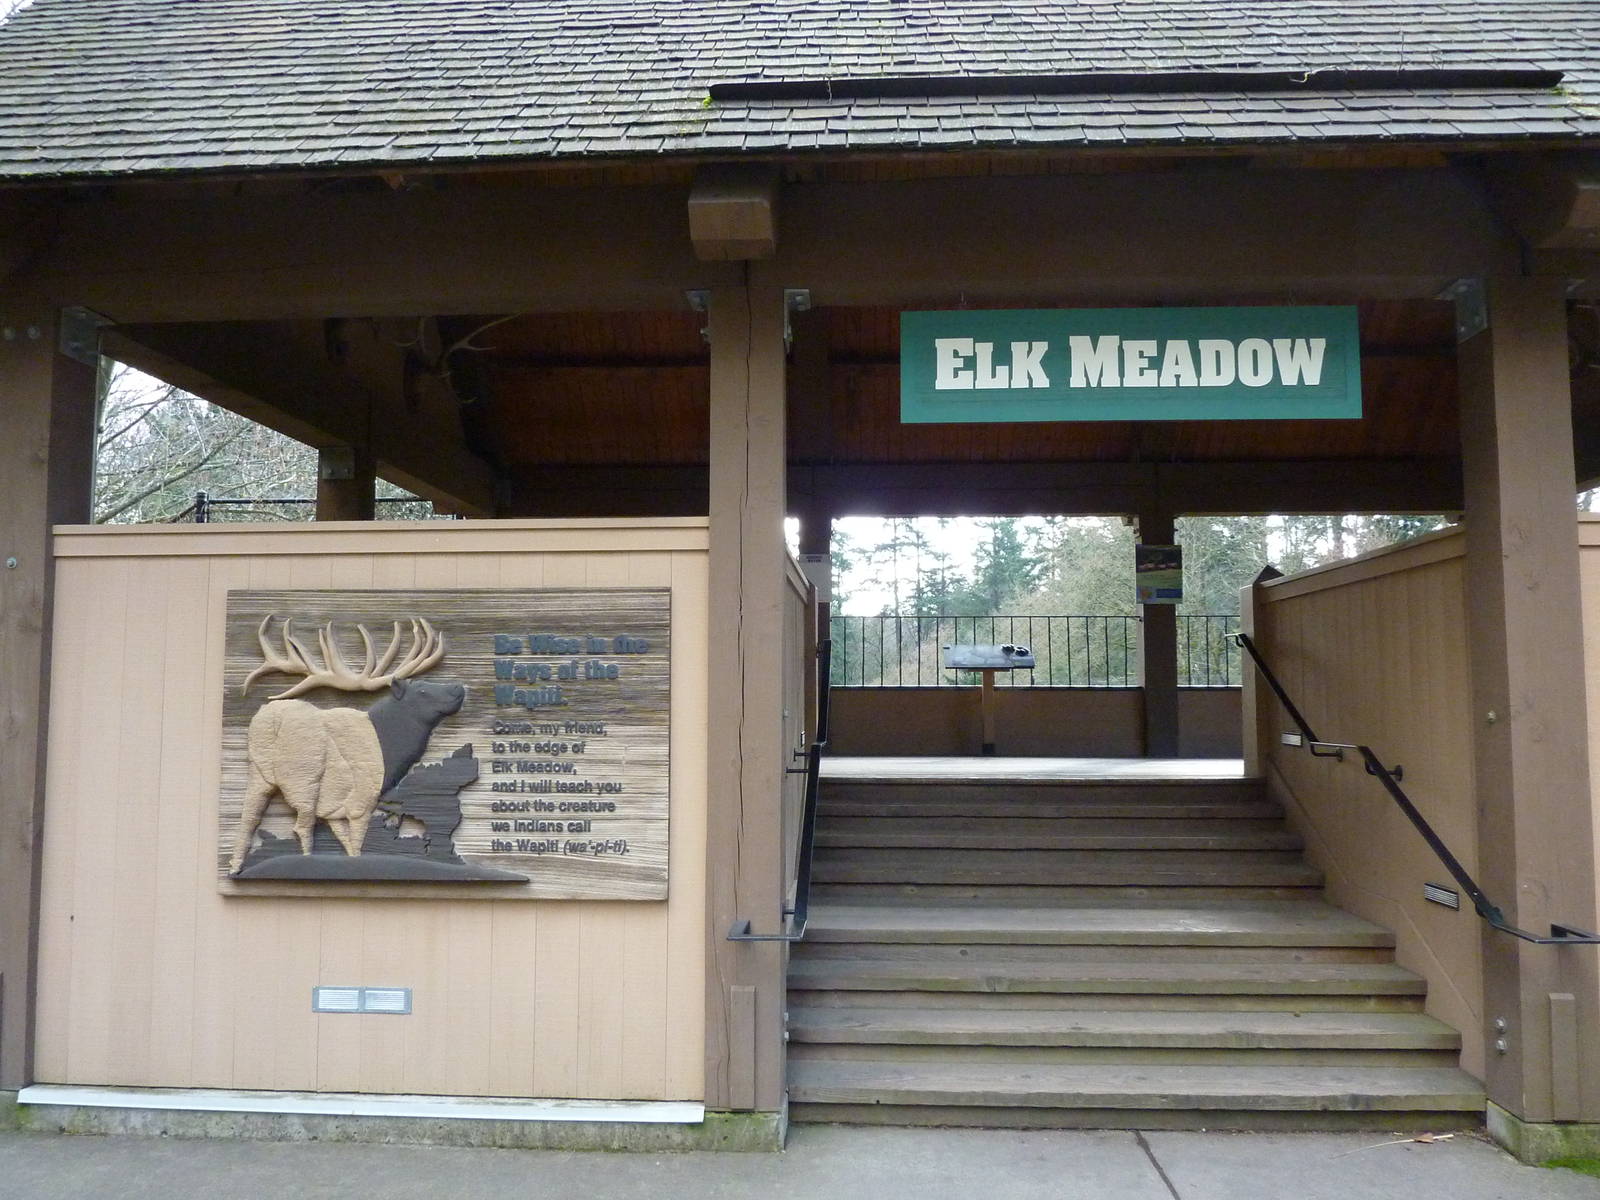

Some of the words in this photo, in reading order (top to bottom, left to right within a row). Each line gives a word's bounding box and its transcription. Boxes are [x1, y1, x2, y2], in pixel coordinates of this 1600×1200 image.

[935, 338, 1050, 390] ELK
[1069, 335, 1326, 388] MEADOW
[494, 634, 522, 654] Be
[586, 633, 608, 654] in
[613, 634, 648, 654] the
[494, 659, 551, 684] Ways
[585, 660, 618, 679] the
[540, 723, 559, 736] my
[492, 741, 505, 753] to
[509, 740, 531, 753] the
[534, 740, 568, 756] edge
[571, 741, 586, 753] of
[492, 760, 513, 773] Elk
[516, 760, 577, 775] Meadow,
[492, 779, 517, 792] and
[520, 779, 525, 792] I
[528, 779, 552, 792] will
[555, 779, 593, 792] teach
[596, 781, 622, 795] you
[491, 799, 530, 812] about
[533, 799, 555, 812] the
[558, 800, 616, 812] creature
[491, 821, 511, 832] we
[514, 819, 564, 832] Indians
[567, 819, 591, 832] call
[491, 839, 512, 852] the
[516, 839, 559, 855] Wapiti
